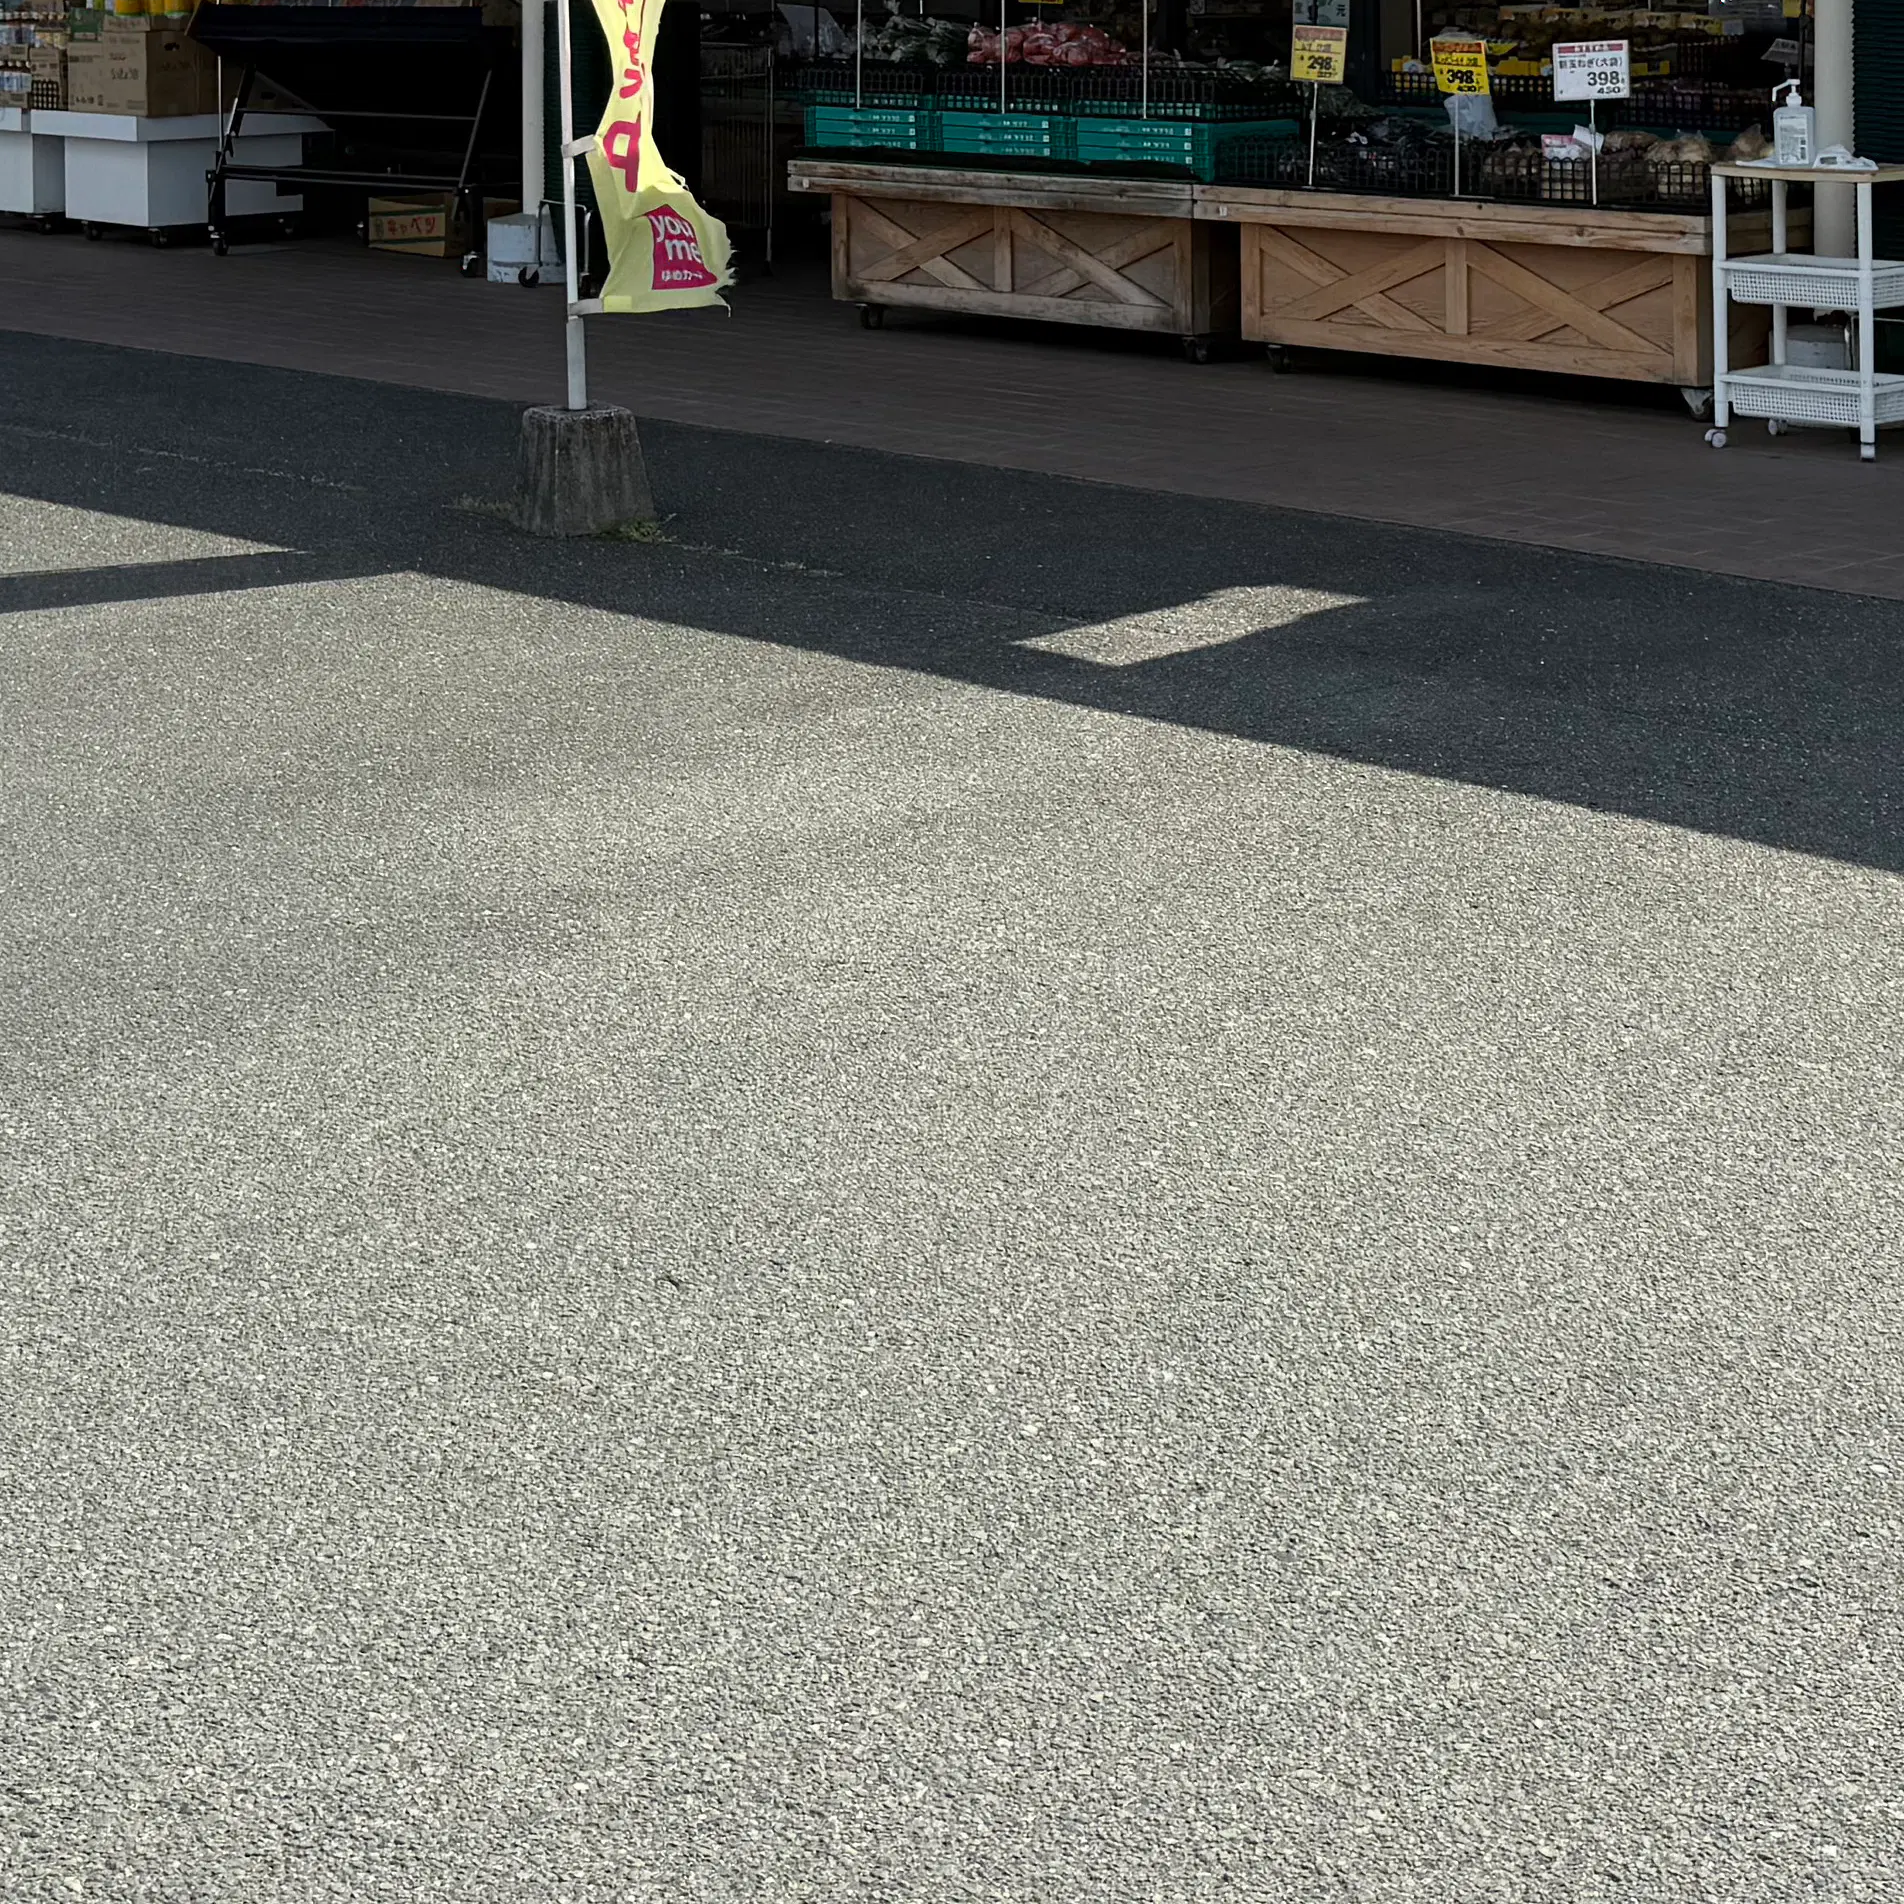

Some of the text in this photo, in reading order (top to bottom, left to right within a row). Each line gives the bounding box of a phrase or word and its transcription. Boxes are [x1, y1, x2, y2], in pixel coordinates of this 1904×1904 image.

[1307, 54, 1333, 71] 298
[1446, 69, 1475, 84] 398
[1586, 70, 1620, 87] 398
[386, 216, 437, 236] キャベツ
[648, 214, 695, 243] you
[664, 238, 704, 265] me
